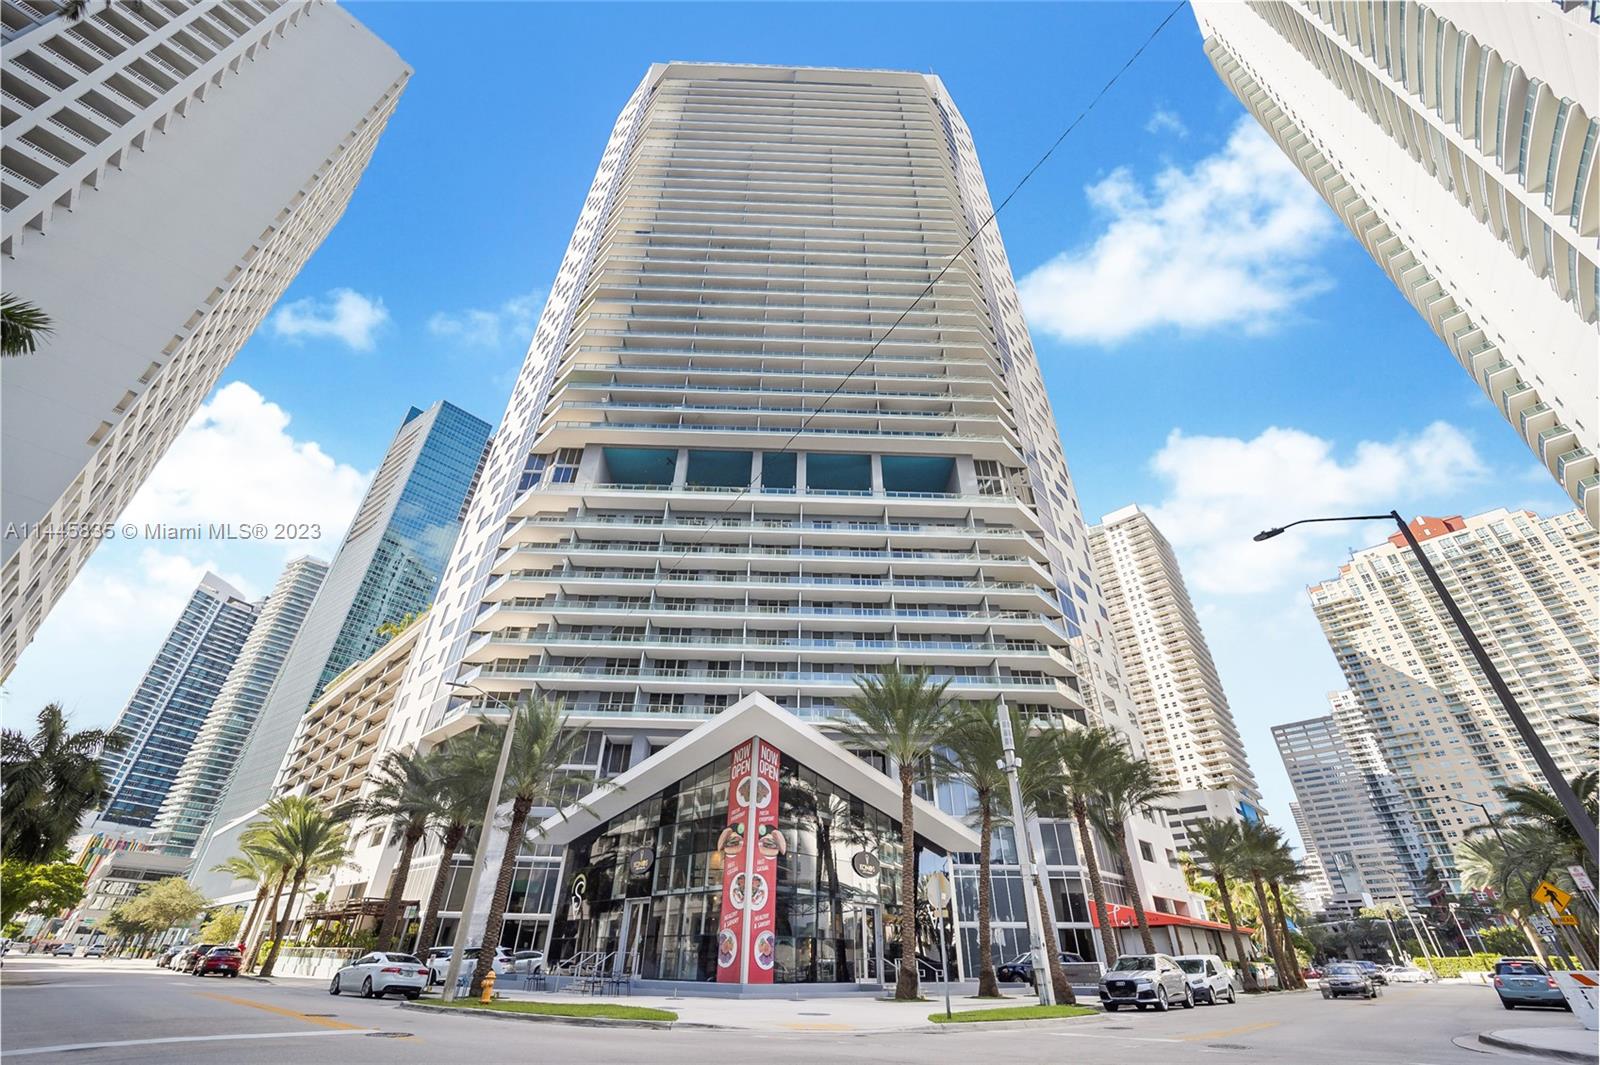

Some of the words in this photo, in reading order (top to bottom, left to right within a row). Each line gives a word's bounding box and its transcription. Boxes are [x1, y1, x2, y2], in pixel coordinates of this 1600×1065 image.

[733, 743, 752, 764] NOW
[761, 745, 779, 766] NOW
[731, 758, 751, 779] OPEN
[759, 759, 779, 781] OPEN
[1537, 925, 1554, 935] 25
